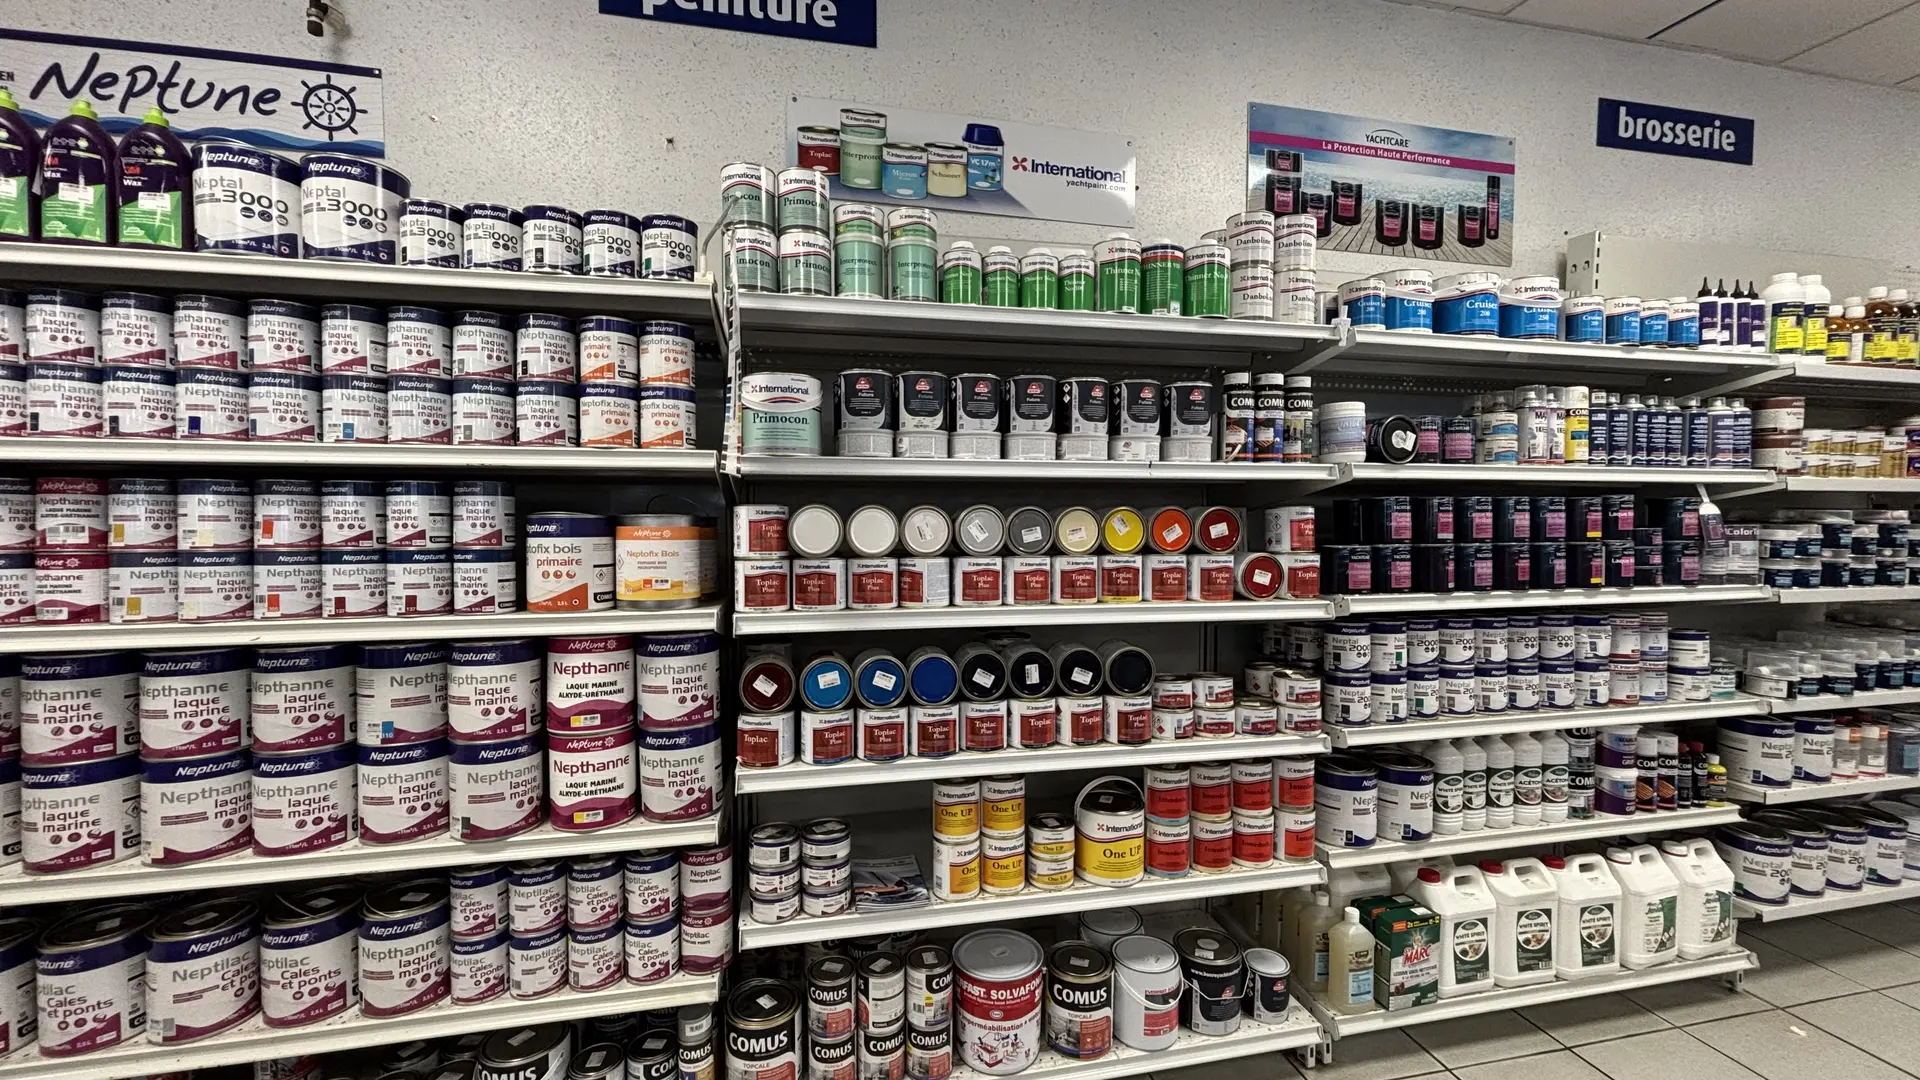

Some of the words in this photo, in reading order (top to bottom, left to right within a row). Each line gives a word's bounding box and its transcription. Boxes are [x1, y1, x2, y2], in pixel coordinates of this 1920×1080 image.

[30, 52, 281, 115] Neptune
[1618, 106, 1735, 151] brosserie
[1365, 134, 1409, 148] YACHTCARE
[201, 151, 259, 165] Neptune
[809, 150, 832, 158] Toplac
[1322, 142, 1332, 150] La
[1334, 142, 1376, 156] Protection
[1377, 150, 1400, 159] Haute
[1402, 151, 1450, 165] Performance
[970, 157, 980, 165] VC
[308, 161, 361, 175] Neptune
[1031, 163, 1126, 183] International
[194, 176, 243, 190] Neptal
[1066, 179, 1126, 192] yachtpaint.com
[302, 186, 346, 199] Neptal
[222, 189, 289, 214] 3000
[784, 197, 825, 209] Primocon
[328, 199, 388, 222] 3000
[408, 205, 442, 214] Neptune
[473, 208, 506, 217] Neptune
[401, 218, 430, 227] Neptal
[546, 211, 577, 223] Neptune
[590, 214, 620, 222] Neptune
[652, 218, 682, 227] Neptune
[465, 222, 495, 231] Neptal
[533, 223, 567, 233] Neptal
[417, 228, 455, 241] 3000
[482, 231, 518, 245] 3000
[644, 232, 672, 241] Neptal
[598, 236, 631, 248] 3000
[661, 240, 692, 253] 3000
[1236, 237, 1271, 246] Danboline
[1278, 239, 1313, 249] Danboline
[1105, 267, 1134, 275] Thinner
[1466, 300, 1498, 308] Cruiser
[456, 329, 508, 341] Nepthanne
[481, 338, 505, 348] laque
[481, 347, 508, 356] marine
[660, 347, 688, 357] primaire
[37, 368, 82, 378] Neptune
[116, 371, 160, 381] Neptune
[195, 373, 238, 384] Neptune
[254, 376, 290, 384] Neptune
[399, 380, 434, 388] Neptune
[759, 385, 809, 395] International
[61, 394, 96, 404] laque
[140, 396, 173, 407] laque
[272, 399, 303, 409] laque
[392, 393, 447, 405] Nepthanne
[272, 407, 309, 416] marine
[417, 403, 442, 413] laque
[601, 409, 631, 419] primaire
[417, 411, 447, 419] marine
[753, 412, 808, 425] Primocon
[42, 482, 85, 491] Neptune
[145, 507, 175, 517] laque
[553, 543, 582, 555] bois
[626, 549, 658, 559] Neptofix
[660, 549, 680, 558] Bois
[192, 555, 235, 564] Neptune
[536, 556, 582, 568] primaire
[861, 577, 884, 585] Toplac
[1112, 572, 1132, 580] Toplac
[217, 579, 246, 589] laque
[756, 579, 780, 587] Toplac
[568, 640, 607, 650] Neptune
[647, 643, 691, 653] Neptune
[145, 660, 201, 671] Neptune
[257, 657, 309, 668] Neptune
[553, 660, 630, 676] Nepthanne
[640, 662, 707, 676] Nepthanne
[566, 682, 589, 691] LAQUE
[591, 679, 618, 690] MARINE
[672, 674, 703, 685] laque
[139, 682, 228, 699] Nepthanne
[474, 686, 511, 698] laque
[558, 687, 625, 699] ALKYDE-URÉTHANNE
[672, 682, 708, 695] marine
[1340, 689, 1366, 697] Neptal
[173, 696, 220, 710] laque
[283, 692, 326, 705] laque
[474, 694, 518, 707] marine
[43, 702, 92, 715] laque
[173, 705, 230, 720] marine
[283, 701, 335, 714] marine
[43, 711, 103, 725] marine
[874, 728, 896, 738] Toplac
[927, 725, 949, 734] Toplac
[744, 734, 768, 743] Toplac
[370, 748, 423, 762] Neptune
[553, 754, 630, 774] Nepthanne
[361, 767, 443, 787] Nepthanne
[566, 779, 589, 788] LAQUE
[590, 776, 618, 787] MARINE
[398, 781, 437, 796] laque
[558, 782, 625, 798] ALKYDE-URÉTHANNE
[943, 790, 976, 799] International
[288, 794, 330, 809] laque
[399, 788, 443, 806] marine
[287, 802, 339, 819] marine
[941, 808, 958, 818] One
[961, 808, 973, 817] UP
[1106, 822, 1144, 833] International
[1160, 830, 1188, 838] International
[1102, 848, 1130, 860] One
[1133, 847, 1142, 858] UP
[992, 861, 1010, 871] One
[1012, 860, 1022, 869] UP
[1743, 856, 1783, 869] Neptal
[691, 868, 720, 878] Neptilac
[370, 920, 423, 936] Neptune
[398, 950, 437, 969] laque
[1405, 946, 1431, 964] MARC
[281, 965, 320, 980] Cales
[399, 956, 444, 979] marine
[281, 980, 295, 990] et
[298, 968, 342, 991] ponts
[810, 986, 848, 1001] COMUS
[991, 979, 1042, 999] SOLVAFON
[1053, 984, 1107, 1005] COMUS
[1068, 1012, 1092, 1020] TOPCALE
[730, 1030, 788, 1054] COMUS
[910, 1030, 948, 1046] COMUS
[679, 1044, 712, 1061] COMUS
[743, 1062, 770, 1070] TOPCALE
